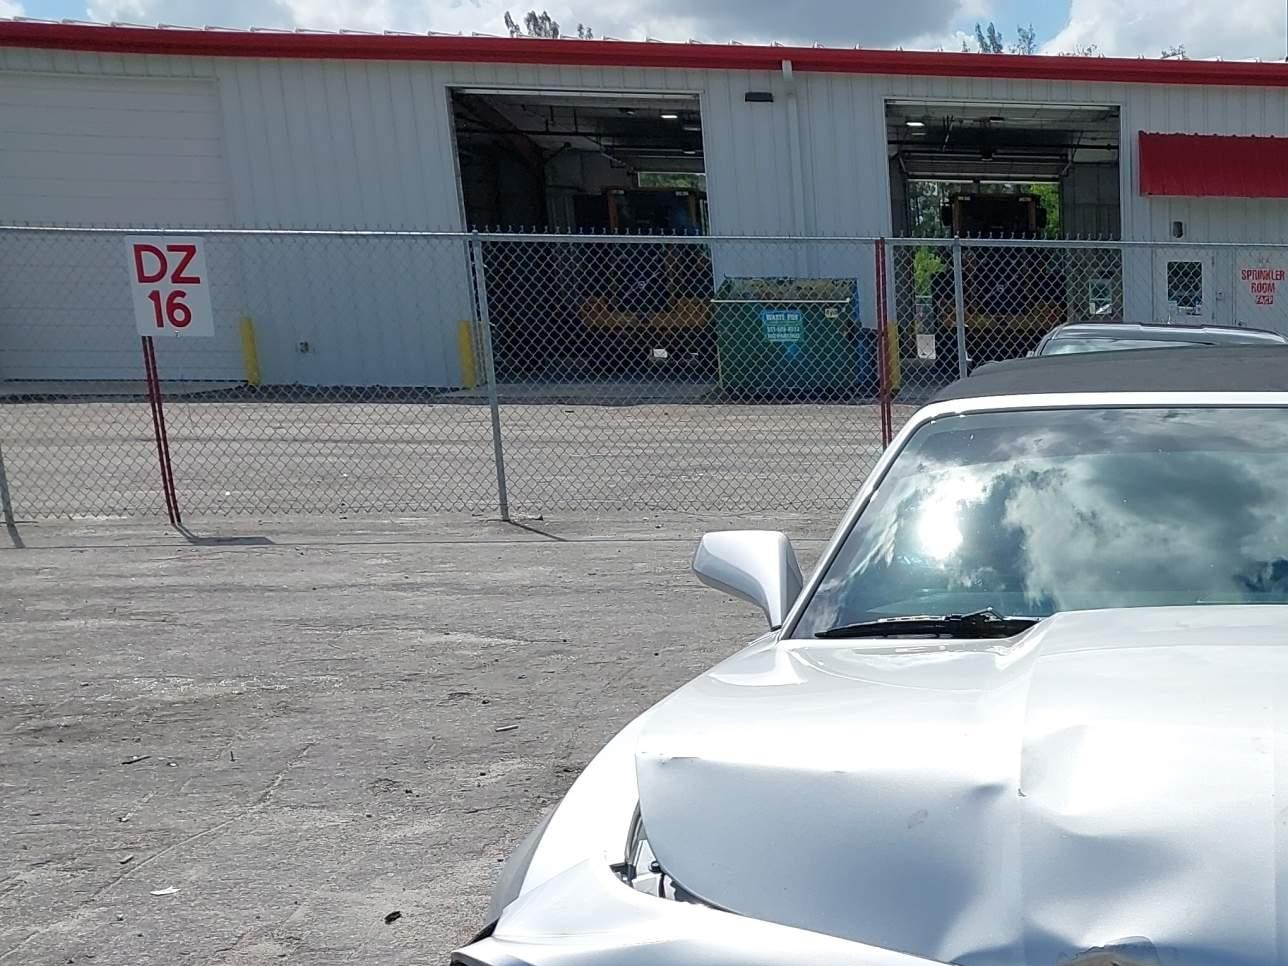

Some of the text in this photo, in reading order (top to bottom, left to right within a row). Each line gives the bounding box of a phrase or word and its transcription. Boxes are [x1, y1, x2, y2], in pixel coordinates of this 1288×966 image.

[133, 244, 201, 284] DZ
[1241, 269, 1285, 281] SPRINKLER
[1251, 282, 1275, 294] ROOM
[148, 290, 192, 328] 16
